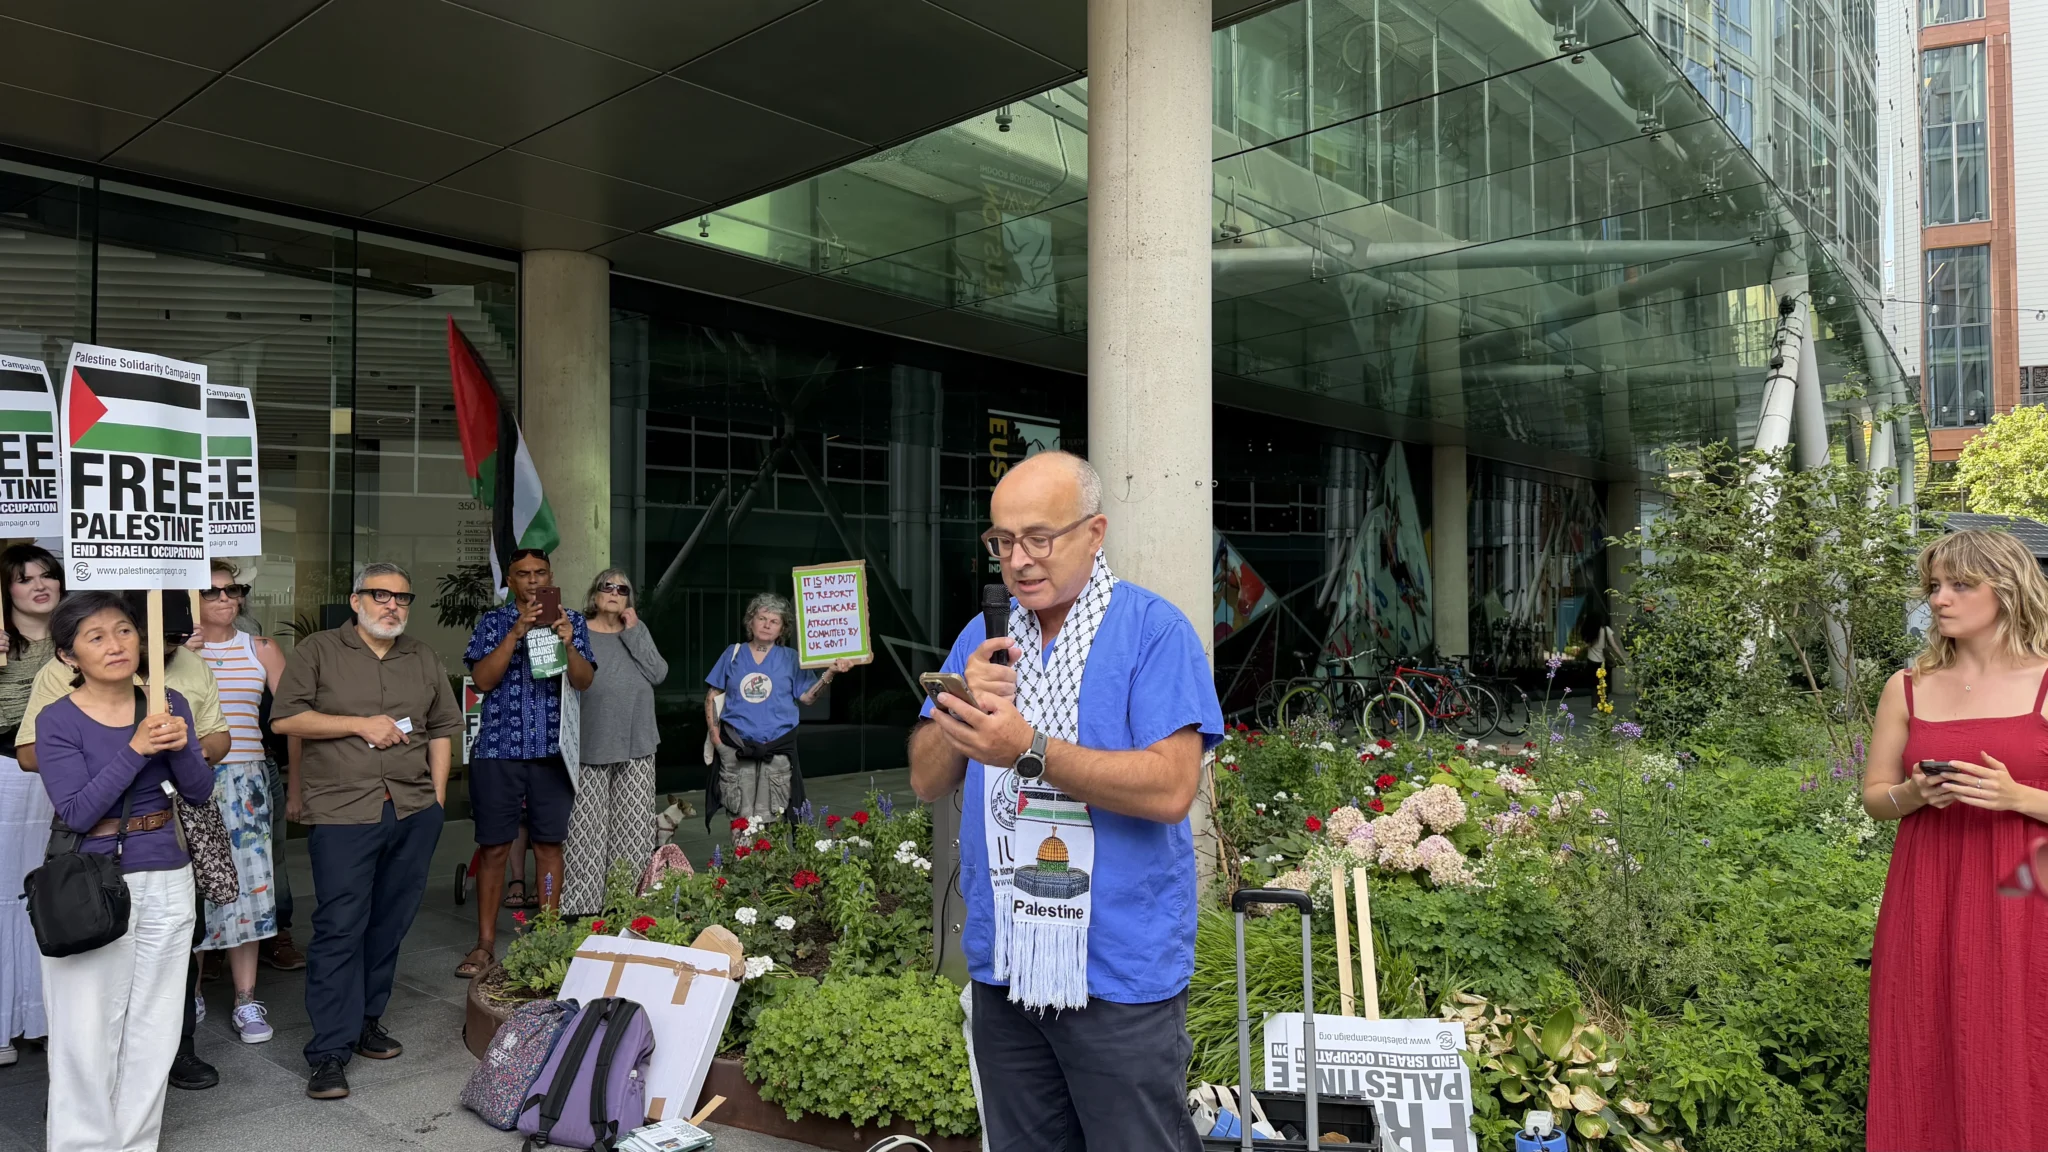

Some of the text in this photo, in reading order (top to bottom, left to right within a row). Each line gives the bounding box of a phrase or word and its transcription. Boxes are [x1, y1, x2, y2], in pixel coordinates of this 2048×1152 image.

[1, 359, 42, 372] Campaign
[75, 351, 201, 382] Palestine Solidarity Campaign
[206, 388, 246, 399] Campaign
[989, 417, 1008, 492] EUS
[0, 479, 58, 500] TINE
[70, 451, 204, 515] FREE
[0, 502, 57, 513] CCUPATION
[458, 501, 476, 511] 350
[71, 512, 203, 543] PALESTINE
[73, 545, 203, 559] END ISRAELI OCCUPATION
[803, 573, 857, 587] IT IS MY DUTY
[803, 589, 855, 601] TO REPORT
[806, 602, 857, 614] HEALTHCARE
[807, 617, 849, 628] ATROCITIES
[807, 627, 859, 638] COMMITTED BY
[529, 644, 555, 657] AGAINST
[808, 641, 822, 650] UK
[530, 656, 543, 666] THE
[1013, 900, 1084, 920] Palestine
[1318, 1032, 1431, 1046] www.palestinecampaign.org
[1297, 1049, 1375, 1065] OCCUPATIN
[1378, 1052, 1428, 1068] ISRAELI
[1431, 1054, 1459, 1068] END
